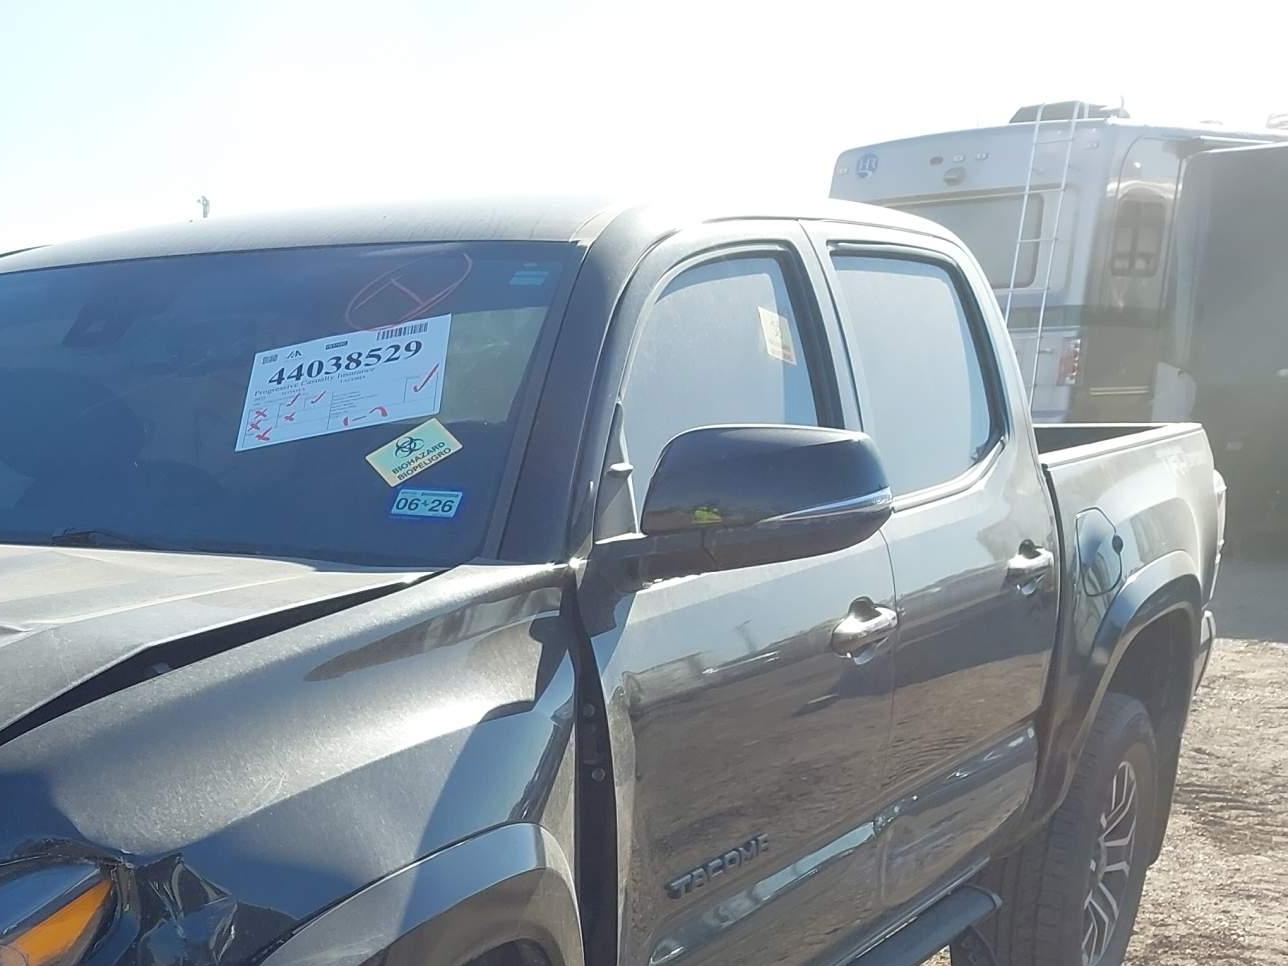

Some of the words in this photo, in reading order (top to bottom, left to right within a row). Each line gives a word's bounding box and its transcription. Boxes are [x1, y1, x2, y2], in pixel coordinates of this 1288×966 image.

[268, 340, 423, 385] 44038529
[392, 441, 446, 475] BIOHAZARD
[397, 447, 452, 480] BIOPELIGRO
